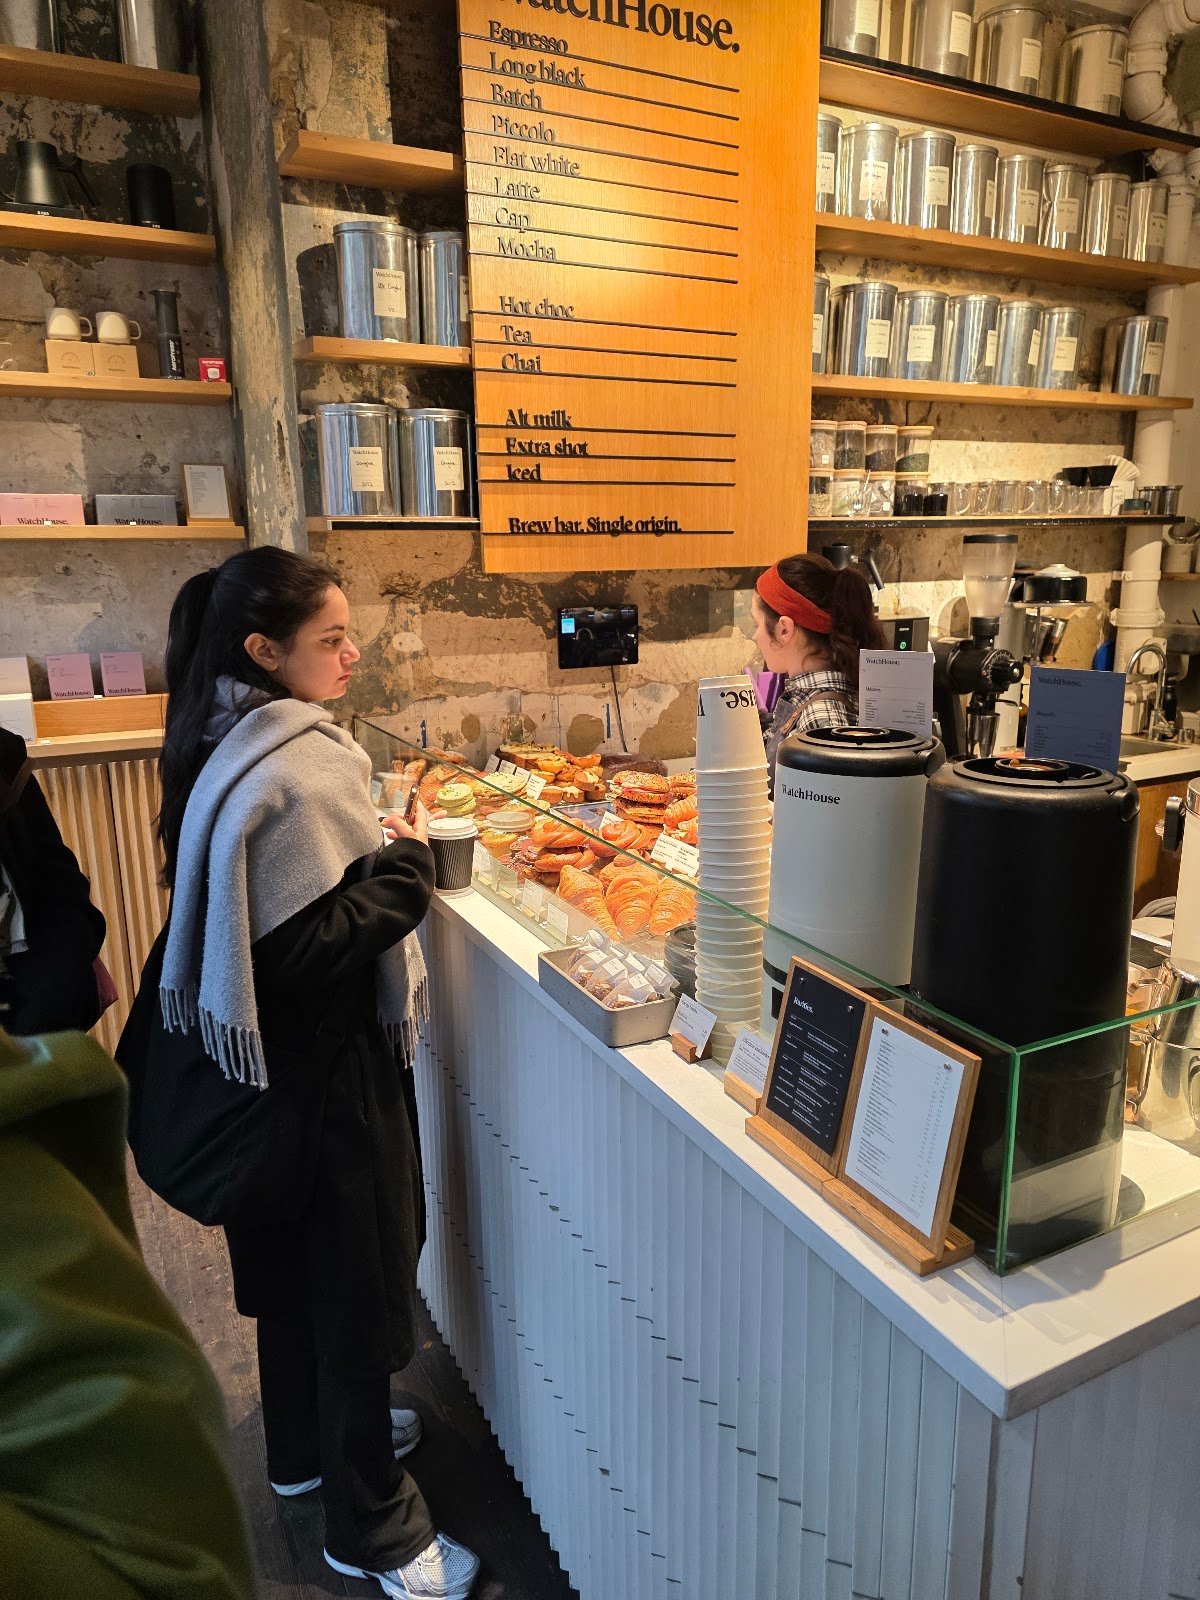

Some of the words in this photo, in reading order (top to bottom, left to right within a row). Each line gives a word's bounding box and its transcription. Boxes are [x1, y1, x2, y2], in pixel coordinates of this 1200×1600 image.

[488, 20, 569, 54] Espresso
[489, 51, 537, 85] Long
[540, 59, 587, 89] black
[491, 83, 543, 111] Batch
[492, 115, 557, 143] Piccolo
[493, 146, 527, 169] Flat
[530, 154, 581, 177] white
[495, 177, 541, 200] Latte
[495, 207, 530, 233] Cap
[497, 237, 557, 260] Mocha
[499, 295, 531, 316] Hot
[535, 298, 575, 319] choc
[500, 325, 532, 344] Tea
[501, 353, 542, 373] Chai
[506, 408, 531, 427] Alt
[534, 410, 572, 428] milk
[506, 437, 551, 455] Extra
[554, 438, 589, 456] shot
[507, 463, 541, 481] Iced
[509, 517, 551, 534] Brew
[554, 516, 584, 533] bar.
[587, 516, 633, 537] Single
[635, 518, 682, 537] origin.
[1038, 676, 1082, 687] WatchHouse.
[781, 783, 841, 805] WatchHouse
